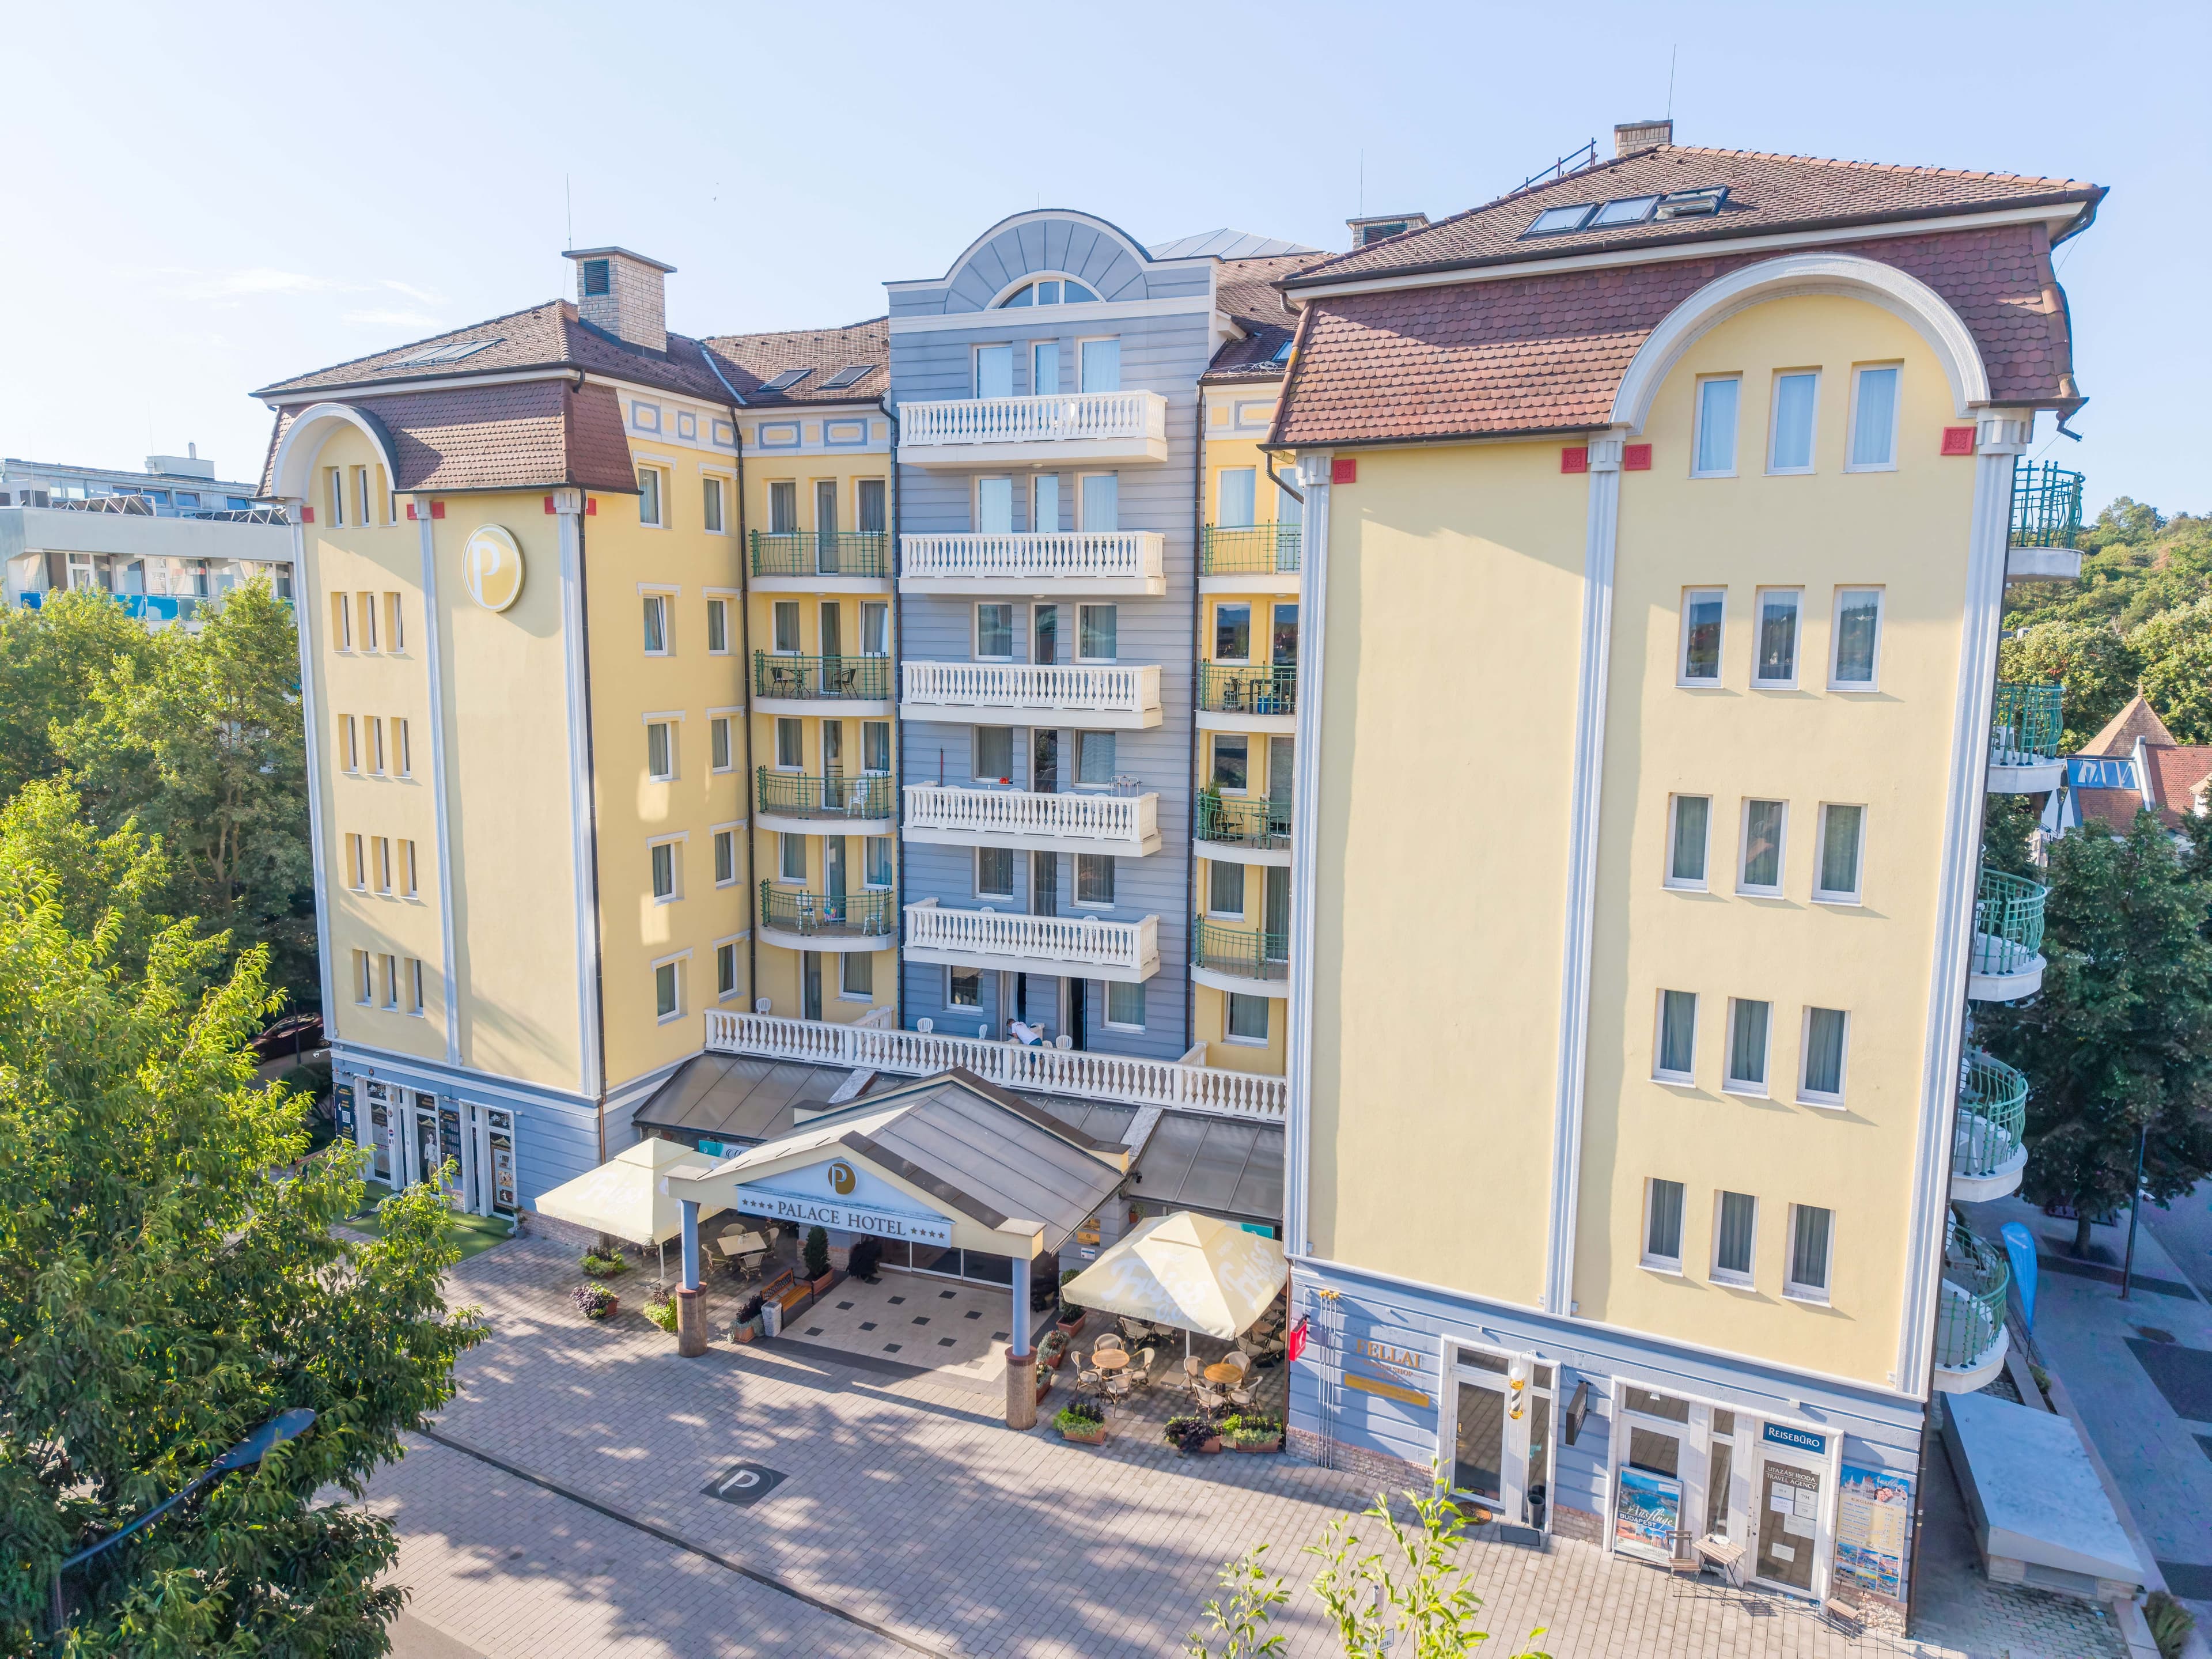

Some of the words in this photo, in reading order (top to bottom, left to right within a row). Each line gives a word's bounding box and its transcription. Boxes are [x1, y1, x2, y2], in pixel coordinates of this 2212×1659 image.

[777, 1201, 840, 1225] PALACE
[848, 1213, 907, 1236] HOTEL
[1356, 1339, 1421, 1369] FELLAI
[1392, 1367, 1413, 1377] SHOP
[1768, 1427, 1820, 1447] REISEBÜRO
[718, 1469, 760, 1495] P
[1767, 1473, 1788, 1483] TRAVEL
[1790, 1479, 1816, 1490] AGENCY
[1795, 1473, 1816, 1483] IRODA
[1851, 1497, 1895, 1511] EXCURSIONS
[1620, 1513, 1657, 1528] BUDAPEST
[1627, 1505, 1673, 1530] Ausflüge
